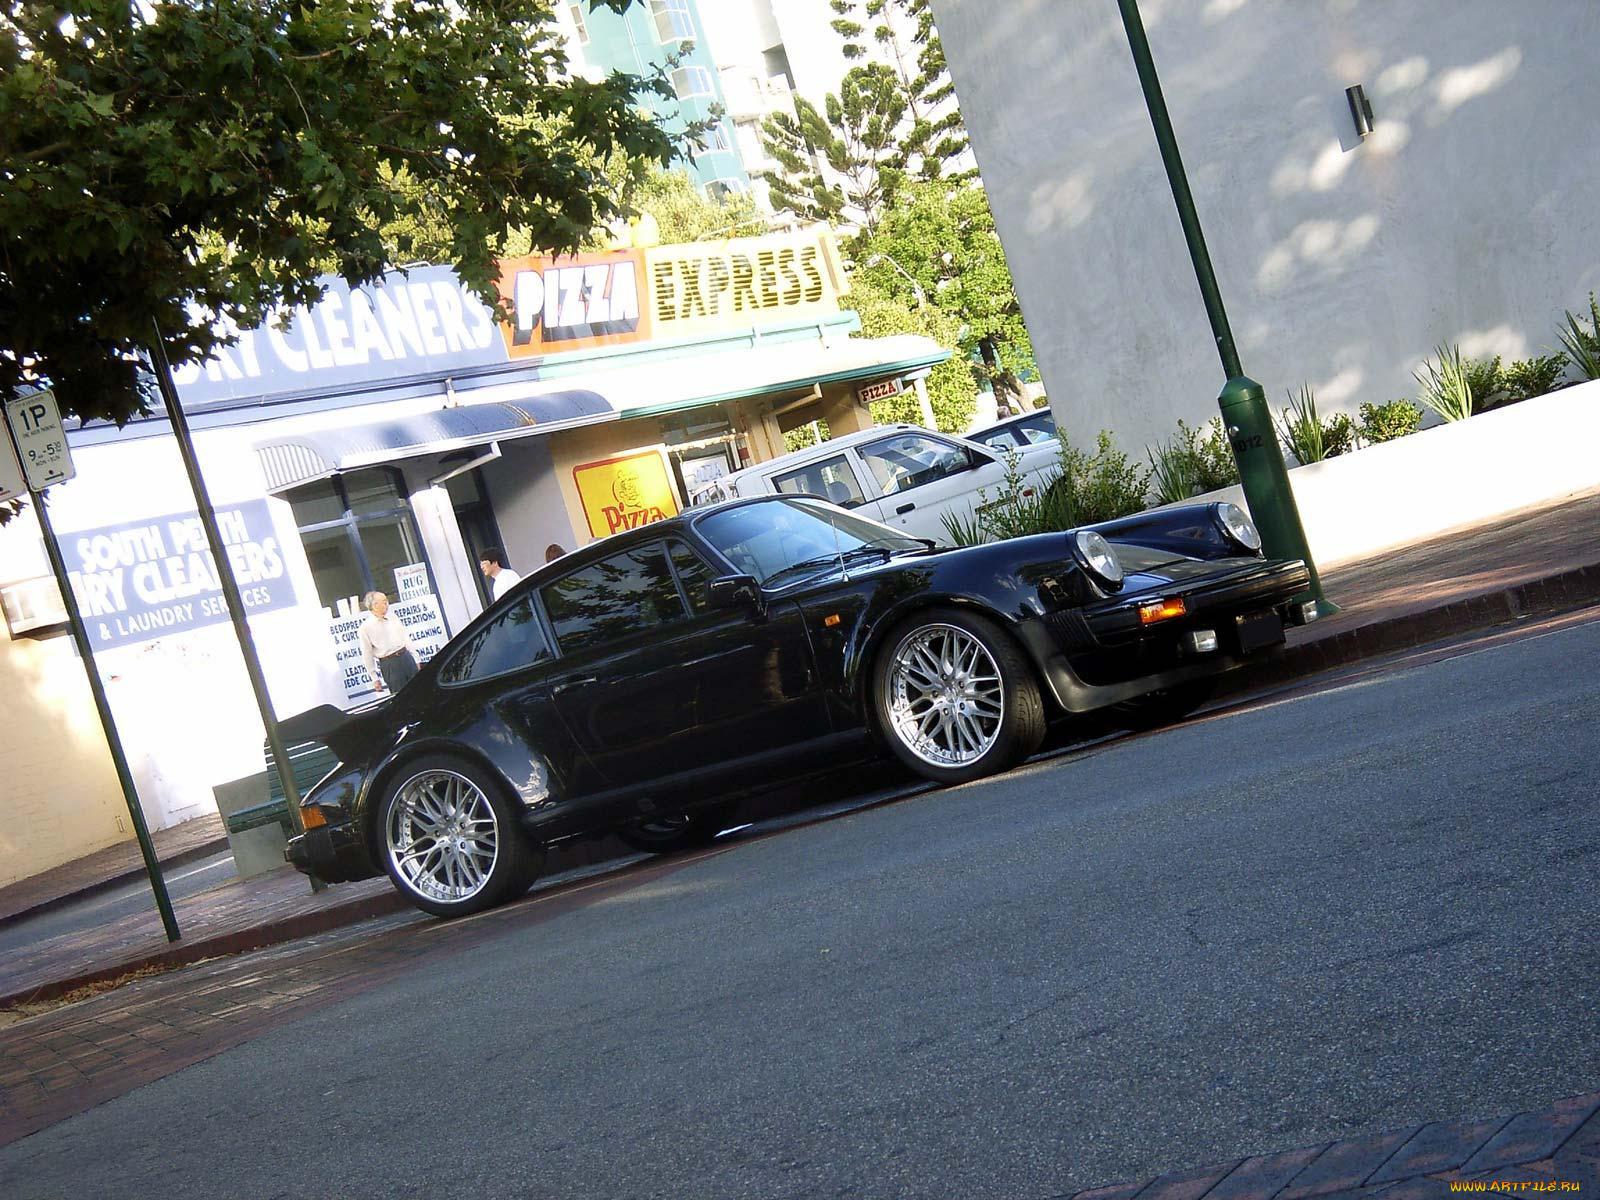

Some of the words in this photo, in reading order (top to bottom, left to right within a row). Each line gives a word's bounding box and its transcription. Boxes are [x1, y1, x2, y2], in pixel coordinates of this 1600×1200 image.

[513, 261, 639, 344] PIZZA
[654, 246, 823, 322] EXPRESS
[264, 280, 494, 372] CLEANERS
[861, 382, 896, 402] PIZZA
[20, 404, 46, 431] 1P
[602, 502, 668, 534] Pizza
[77, 525, 168, 572] SOUTH
[168, 510, 250, 553] PETH
[133, 537, 284, 605] CLEAERS
[402, 575, 424, 590] RUG
[99, 622, 112, 641] &
[119, 602, 193, 636] LAUNDRY
[203, 587, 271, 617] SERCES
[394, 604, 421, 619] REPAIRS
